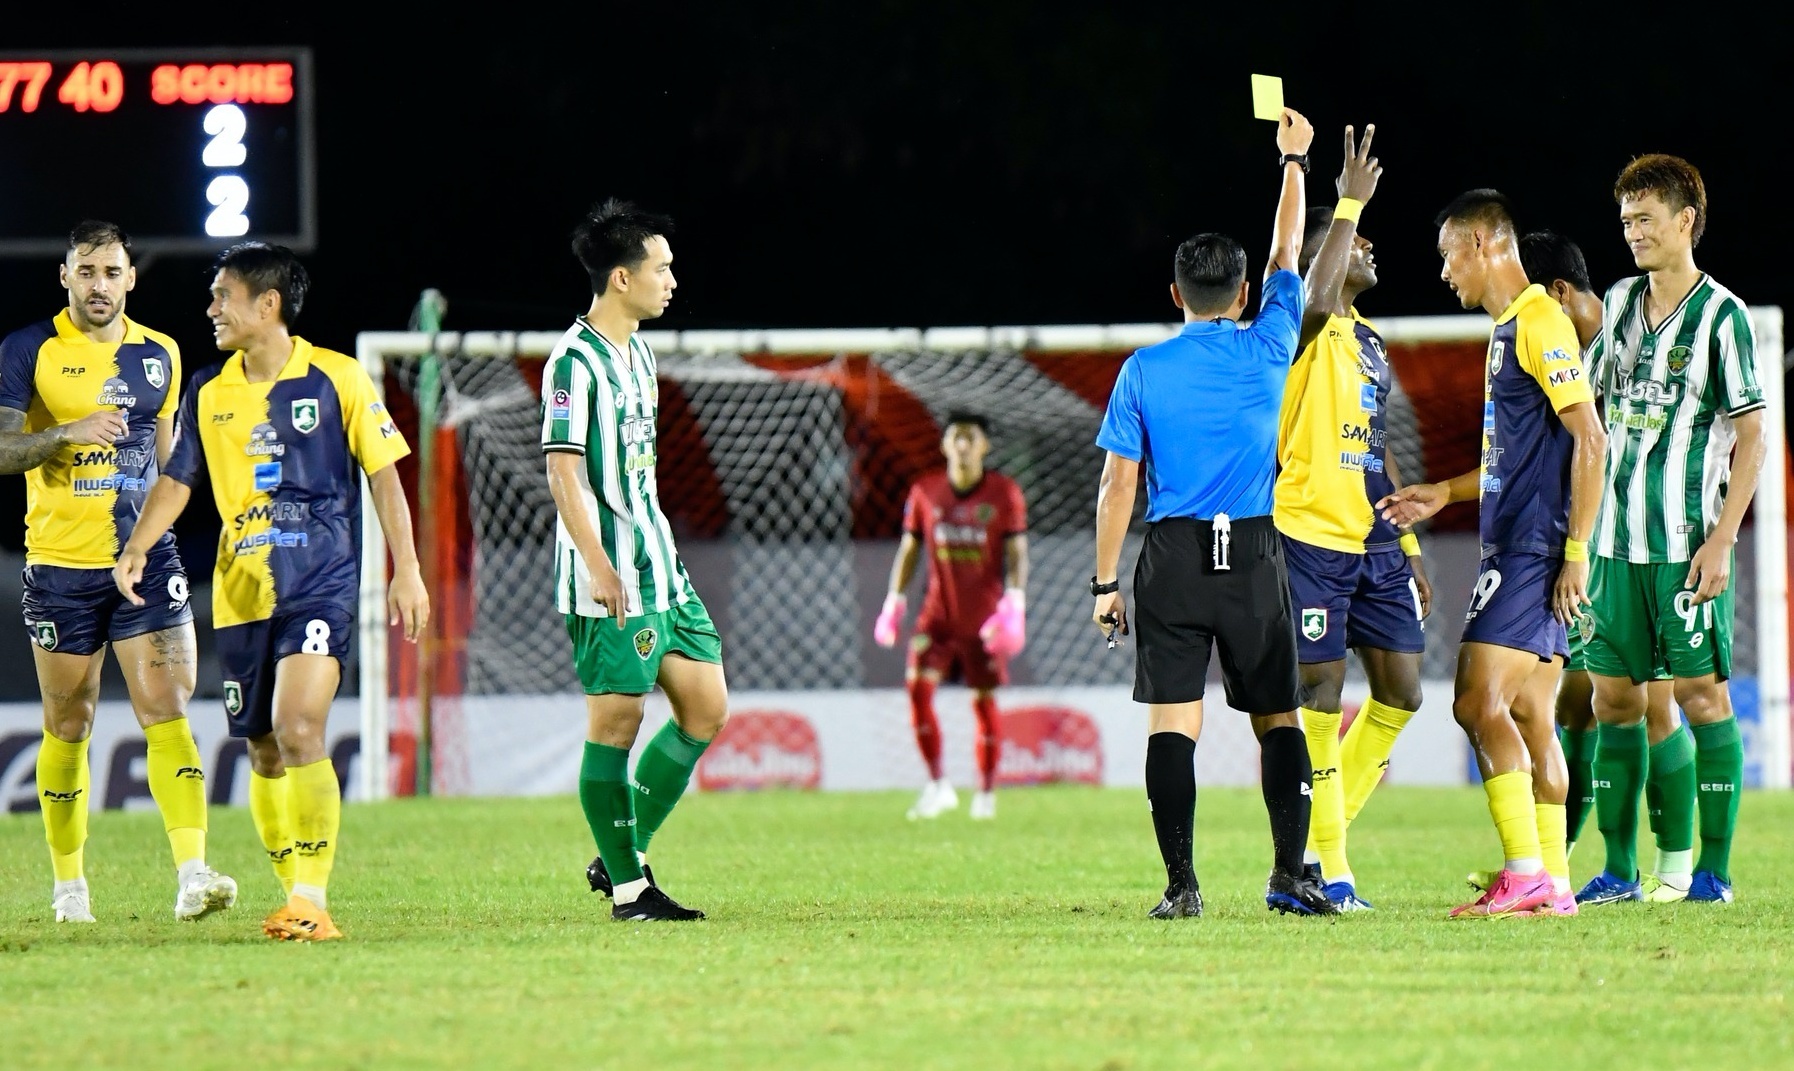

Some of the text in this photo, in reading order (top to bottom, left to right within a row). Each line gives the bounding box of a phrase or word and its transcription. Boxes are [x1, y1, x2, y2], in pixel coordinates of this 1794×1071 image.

[58, 61, 124, 113] 40
[151, 63, 293, 105] SCORE
[203, 103, 247, 167] 2
[205, 175, 250, 237] 2
[62, 367, 86, 375] PKP
[1548, 368, 1580, 388] MKP
[96, 393, 137, 408] Chang
[212, 412, 234, 424] PKP
[1341, 423, 1388, 449] SAMAR
[245, 441, 285, 457] Chang
[1673, 590, 1713, 632] 91
[301, 619, 331, 656] 8
[44, 789, 83, 800] PKP
[1700, 783, 1735, 792] EGO
[295, 840, 328, 852] PKP
